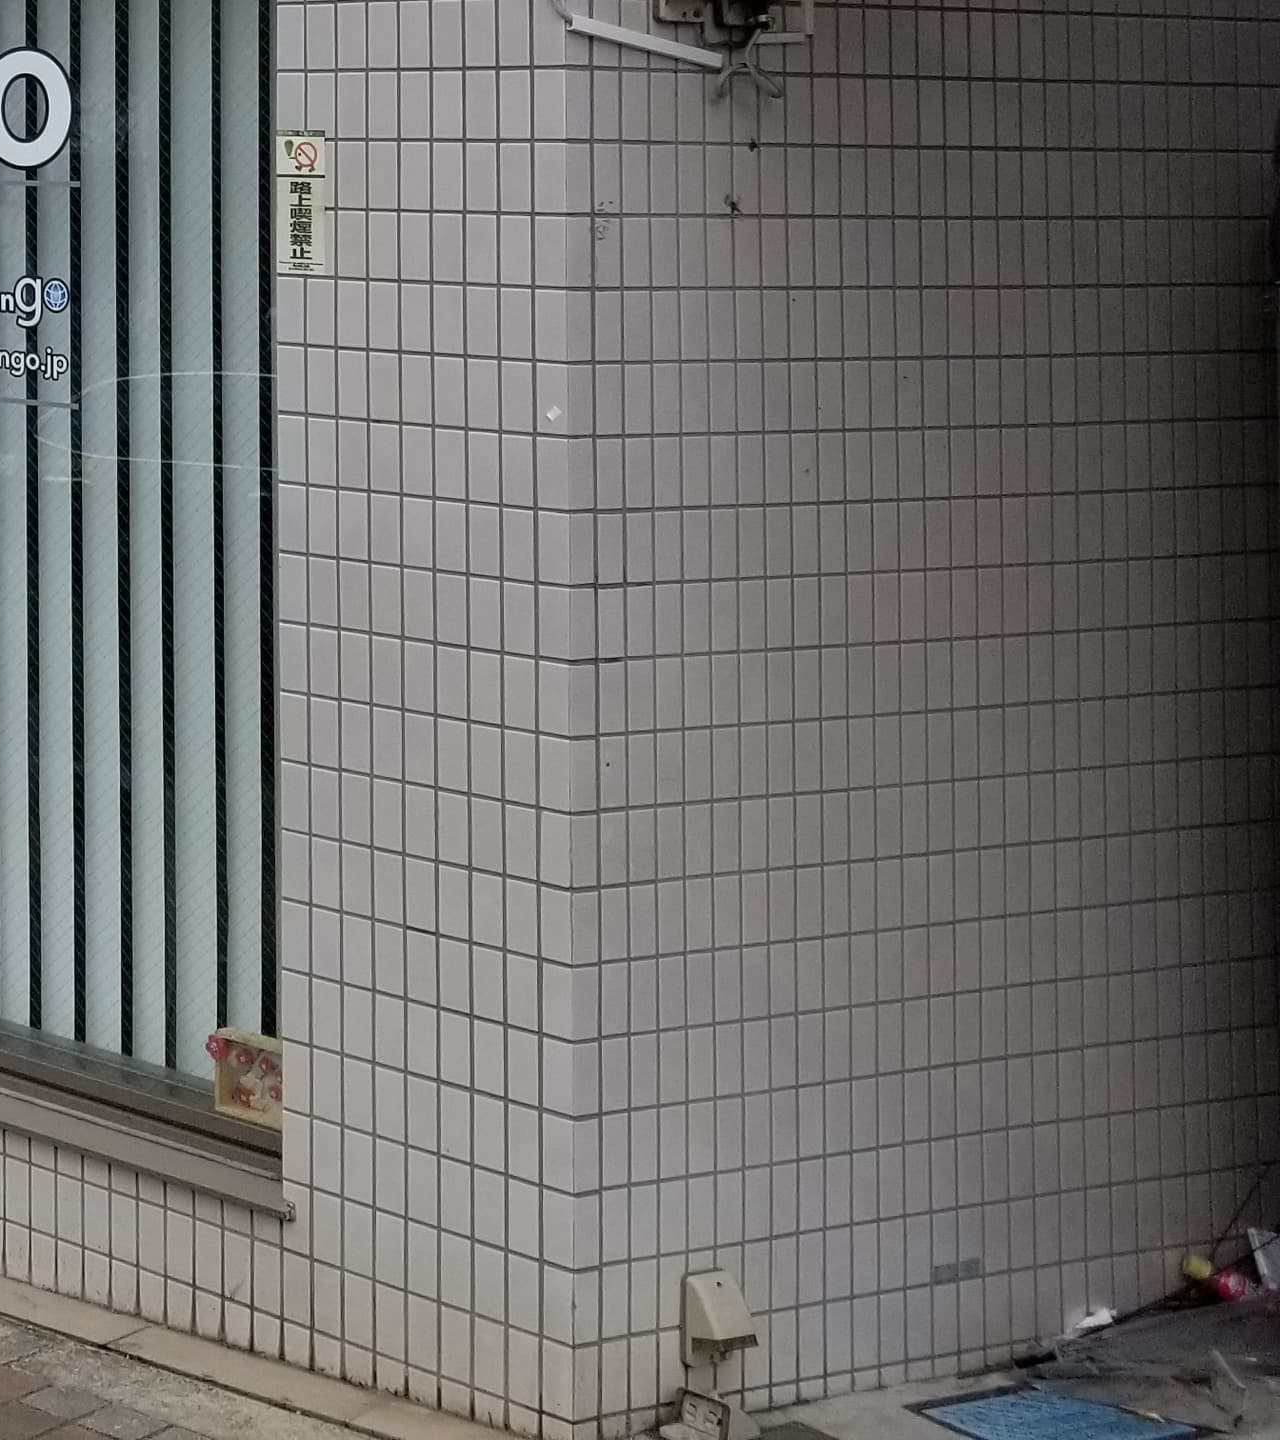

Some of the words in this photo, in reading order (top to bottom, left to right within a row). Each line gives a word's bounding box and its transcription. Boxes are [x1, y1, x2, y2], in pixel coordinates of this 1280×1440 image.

[289, 181, 313, 260] 路上喫煙禁止
